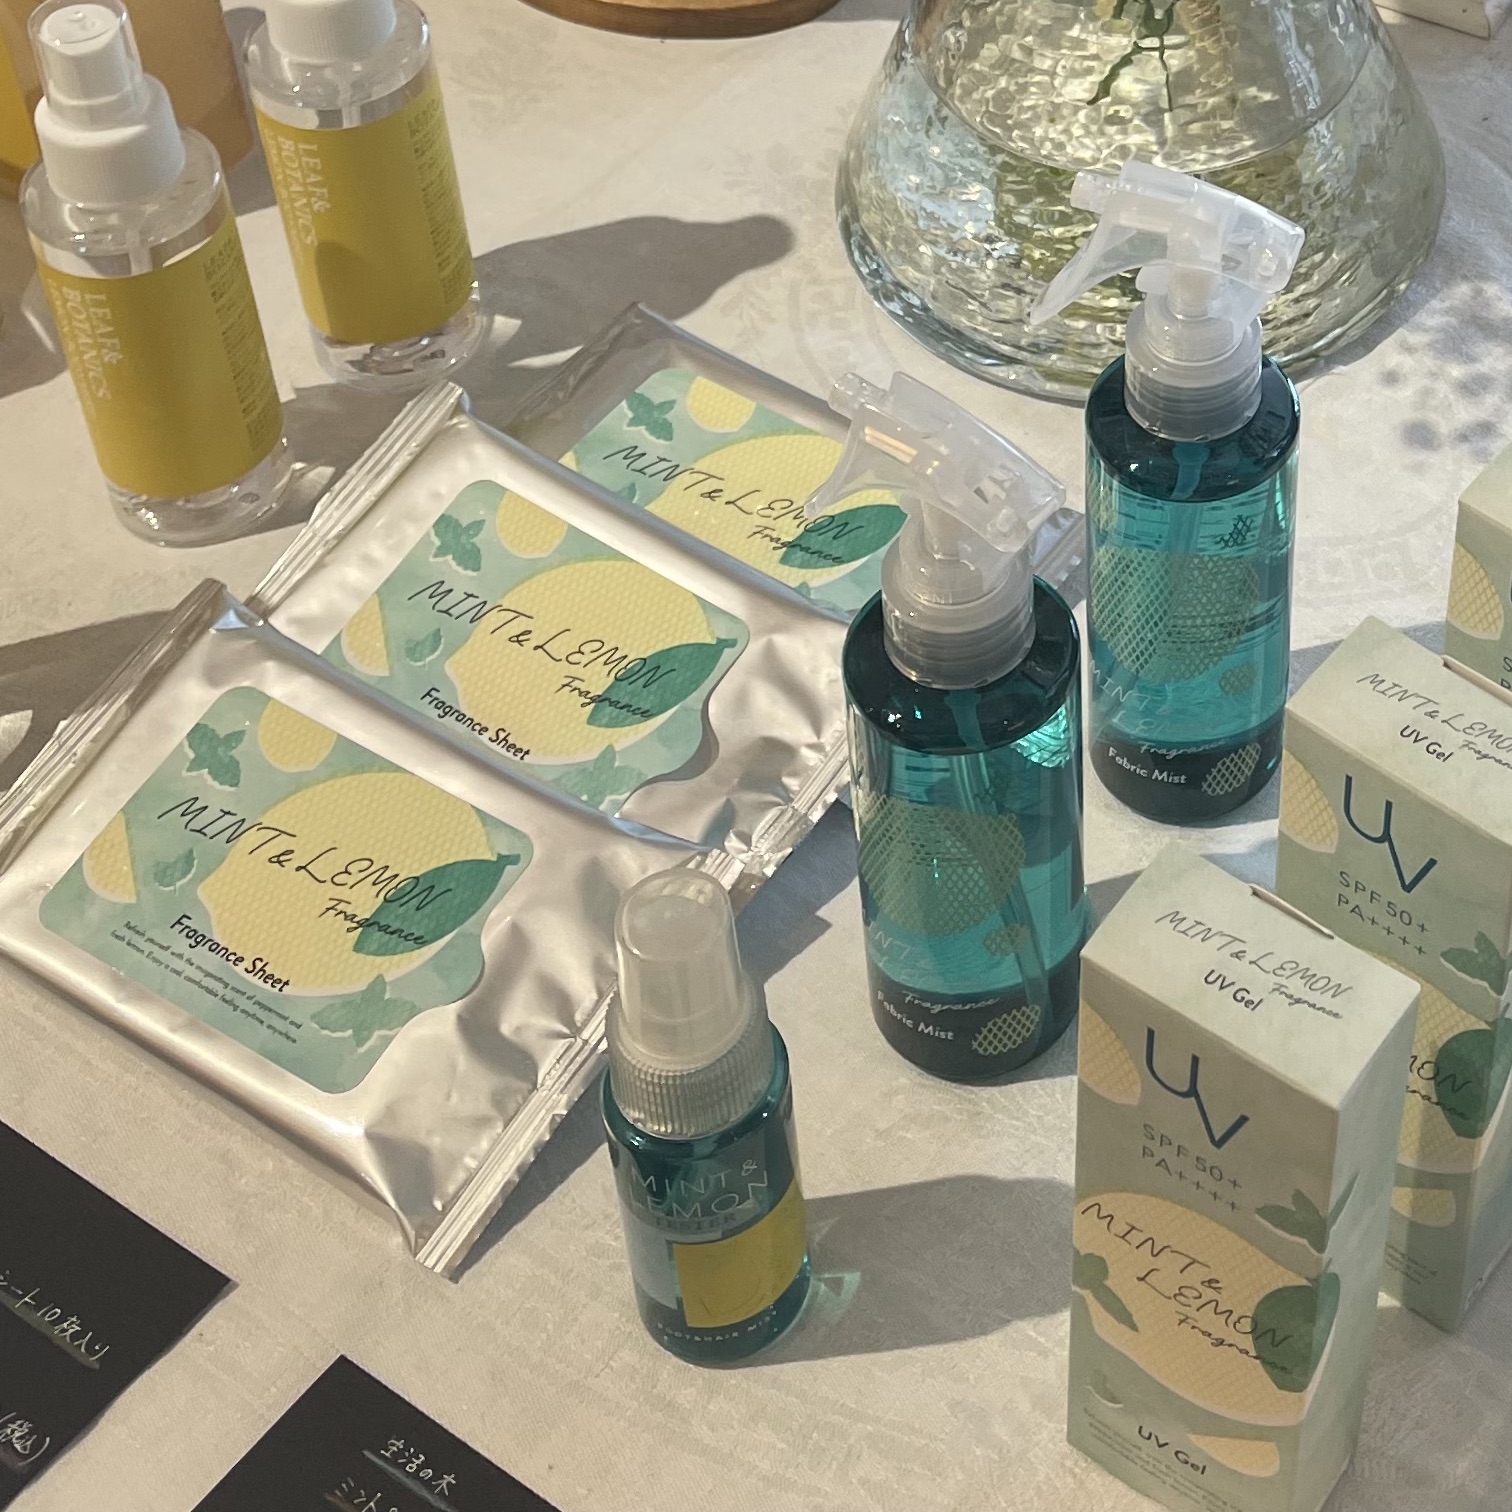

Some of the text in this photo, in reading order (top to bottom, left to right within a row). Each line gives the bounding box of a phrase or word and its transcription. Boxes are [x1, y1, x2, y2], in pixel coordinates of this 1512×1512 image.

[746, 524, 847, 565] Fragrance
[555, 675, 655, 720] Fragrance
[419, 687, 531, 762] Fragrance Sheet
[1138, 738, 1227, 760] Fragrance
[1399, 724, 1455, 763] UV Gel
[1108, 746, 1188, 785] Fabric Mist
[1343, 774, 1438, 894] UV
[318, 897, 431, 948] Fragrance
[169, 914, 291, 993] Fragrance Sheet
[877, 990, 955, 1041] Fabric Mist
[902, 990, 1001, 1015] Fragrance
[1203, 968, 1265, 1013] UV Gel
[1268, 982, 1344, 1020] Fragrance
[1145, 1026, 1249, 1150] UV
[629, 1170, 768, 1219] LEMON
[631, 1166, 733, 1199] MINT
[1136, 1267, 1293, 1348] LEMON
[1174, 1309, 1293, 1376] Fragrance
[380, 1436, 457, 1497] 生活の木
[1138, 1425, 1207, 1476] UV Gel
